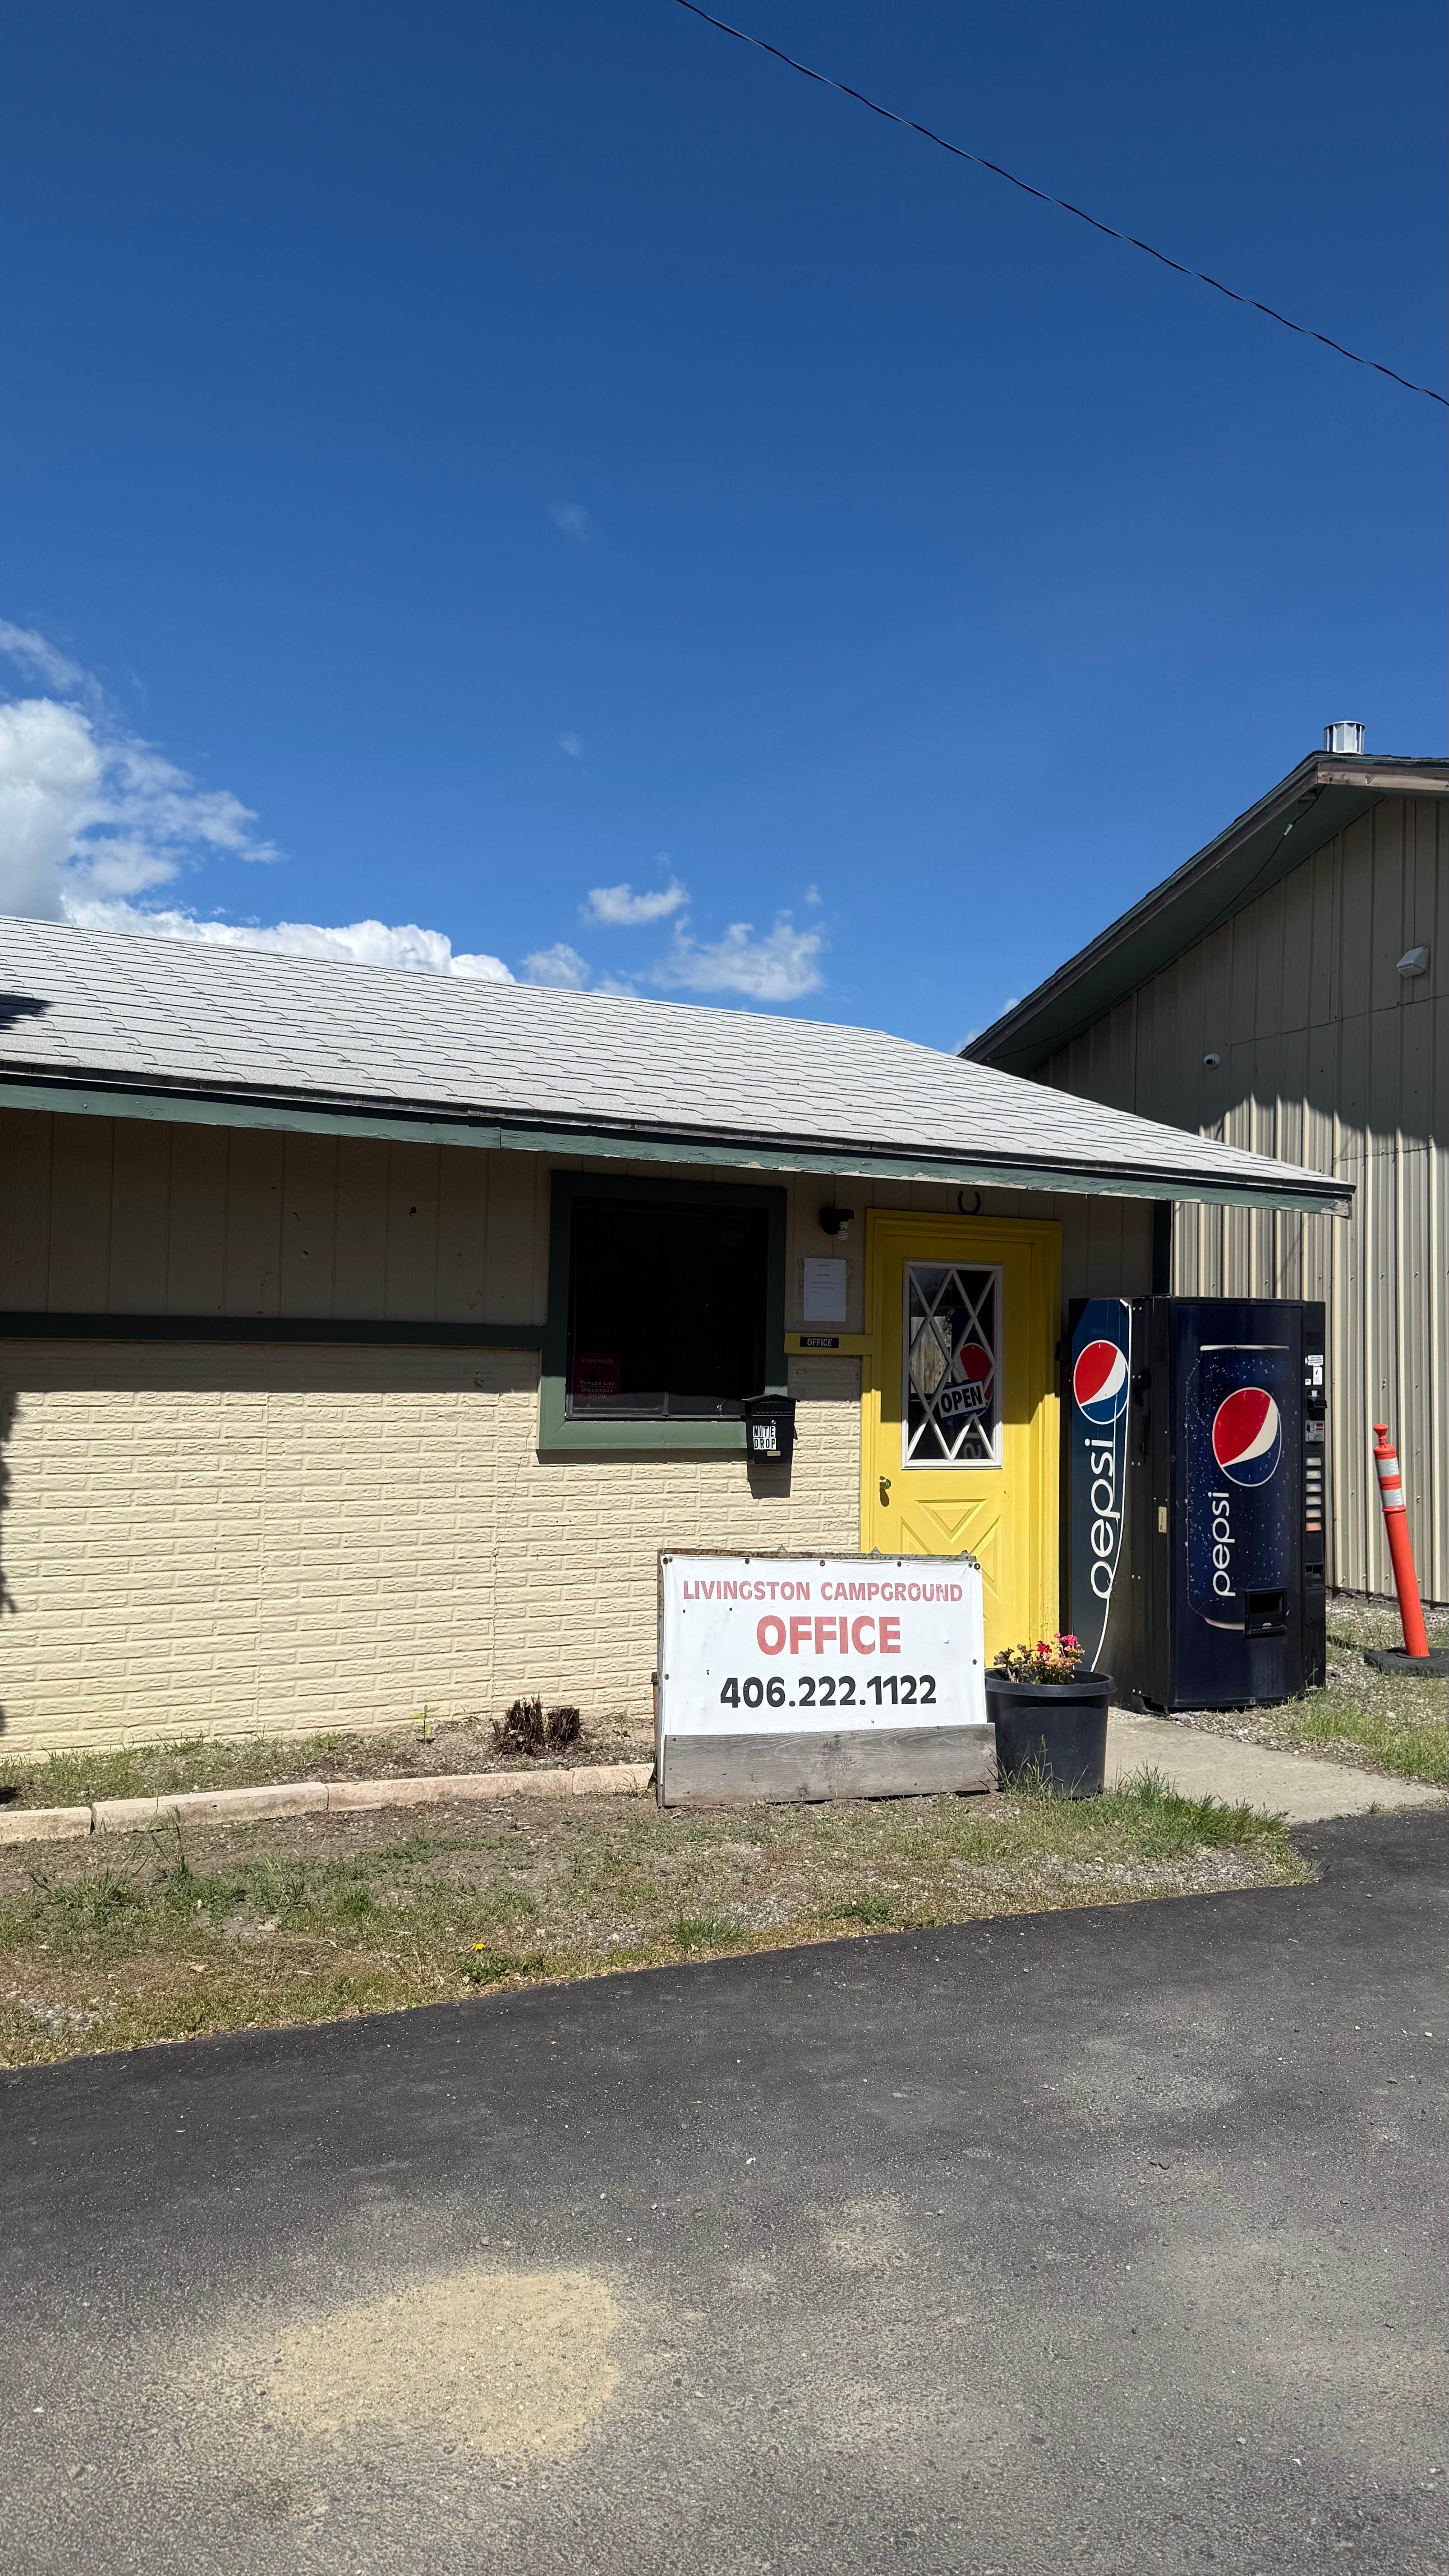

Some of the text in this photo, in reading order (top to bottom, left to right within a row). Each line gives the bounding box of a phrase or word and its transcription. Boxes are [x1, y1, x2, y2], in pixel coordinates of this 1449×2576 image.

[807, 1338, 833, 1347] OFFICE
[941, 1385, 983, 1413] OPEN
[754, 1426, 774, 1437] NITE
[754, 1438, 776, 1449] DROP
[1085, 1439, 1120, 1599] pepsi
[1208, 1491, 1236, 1597] pepsi
[684, 1581, 962, 1601] LIVINGSTON CAMPGROUND
[757, 1615, 901, 1655] OFFICE
[720, 1674, 937, 1708] 406.222.1122
